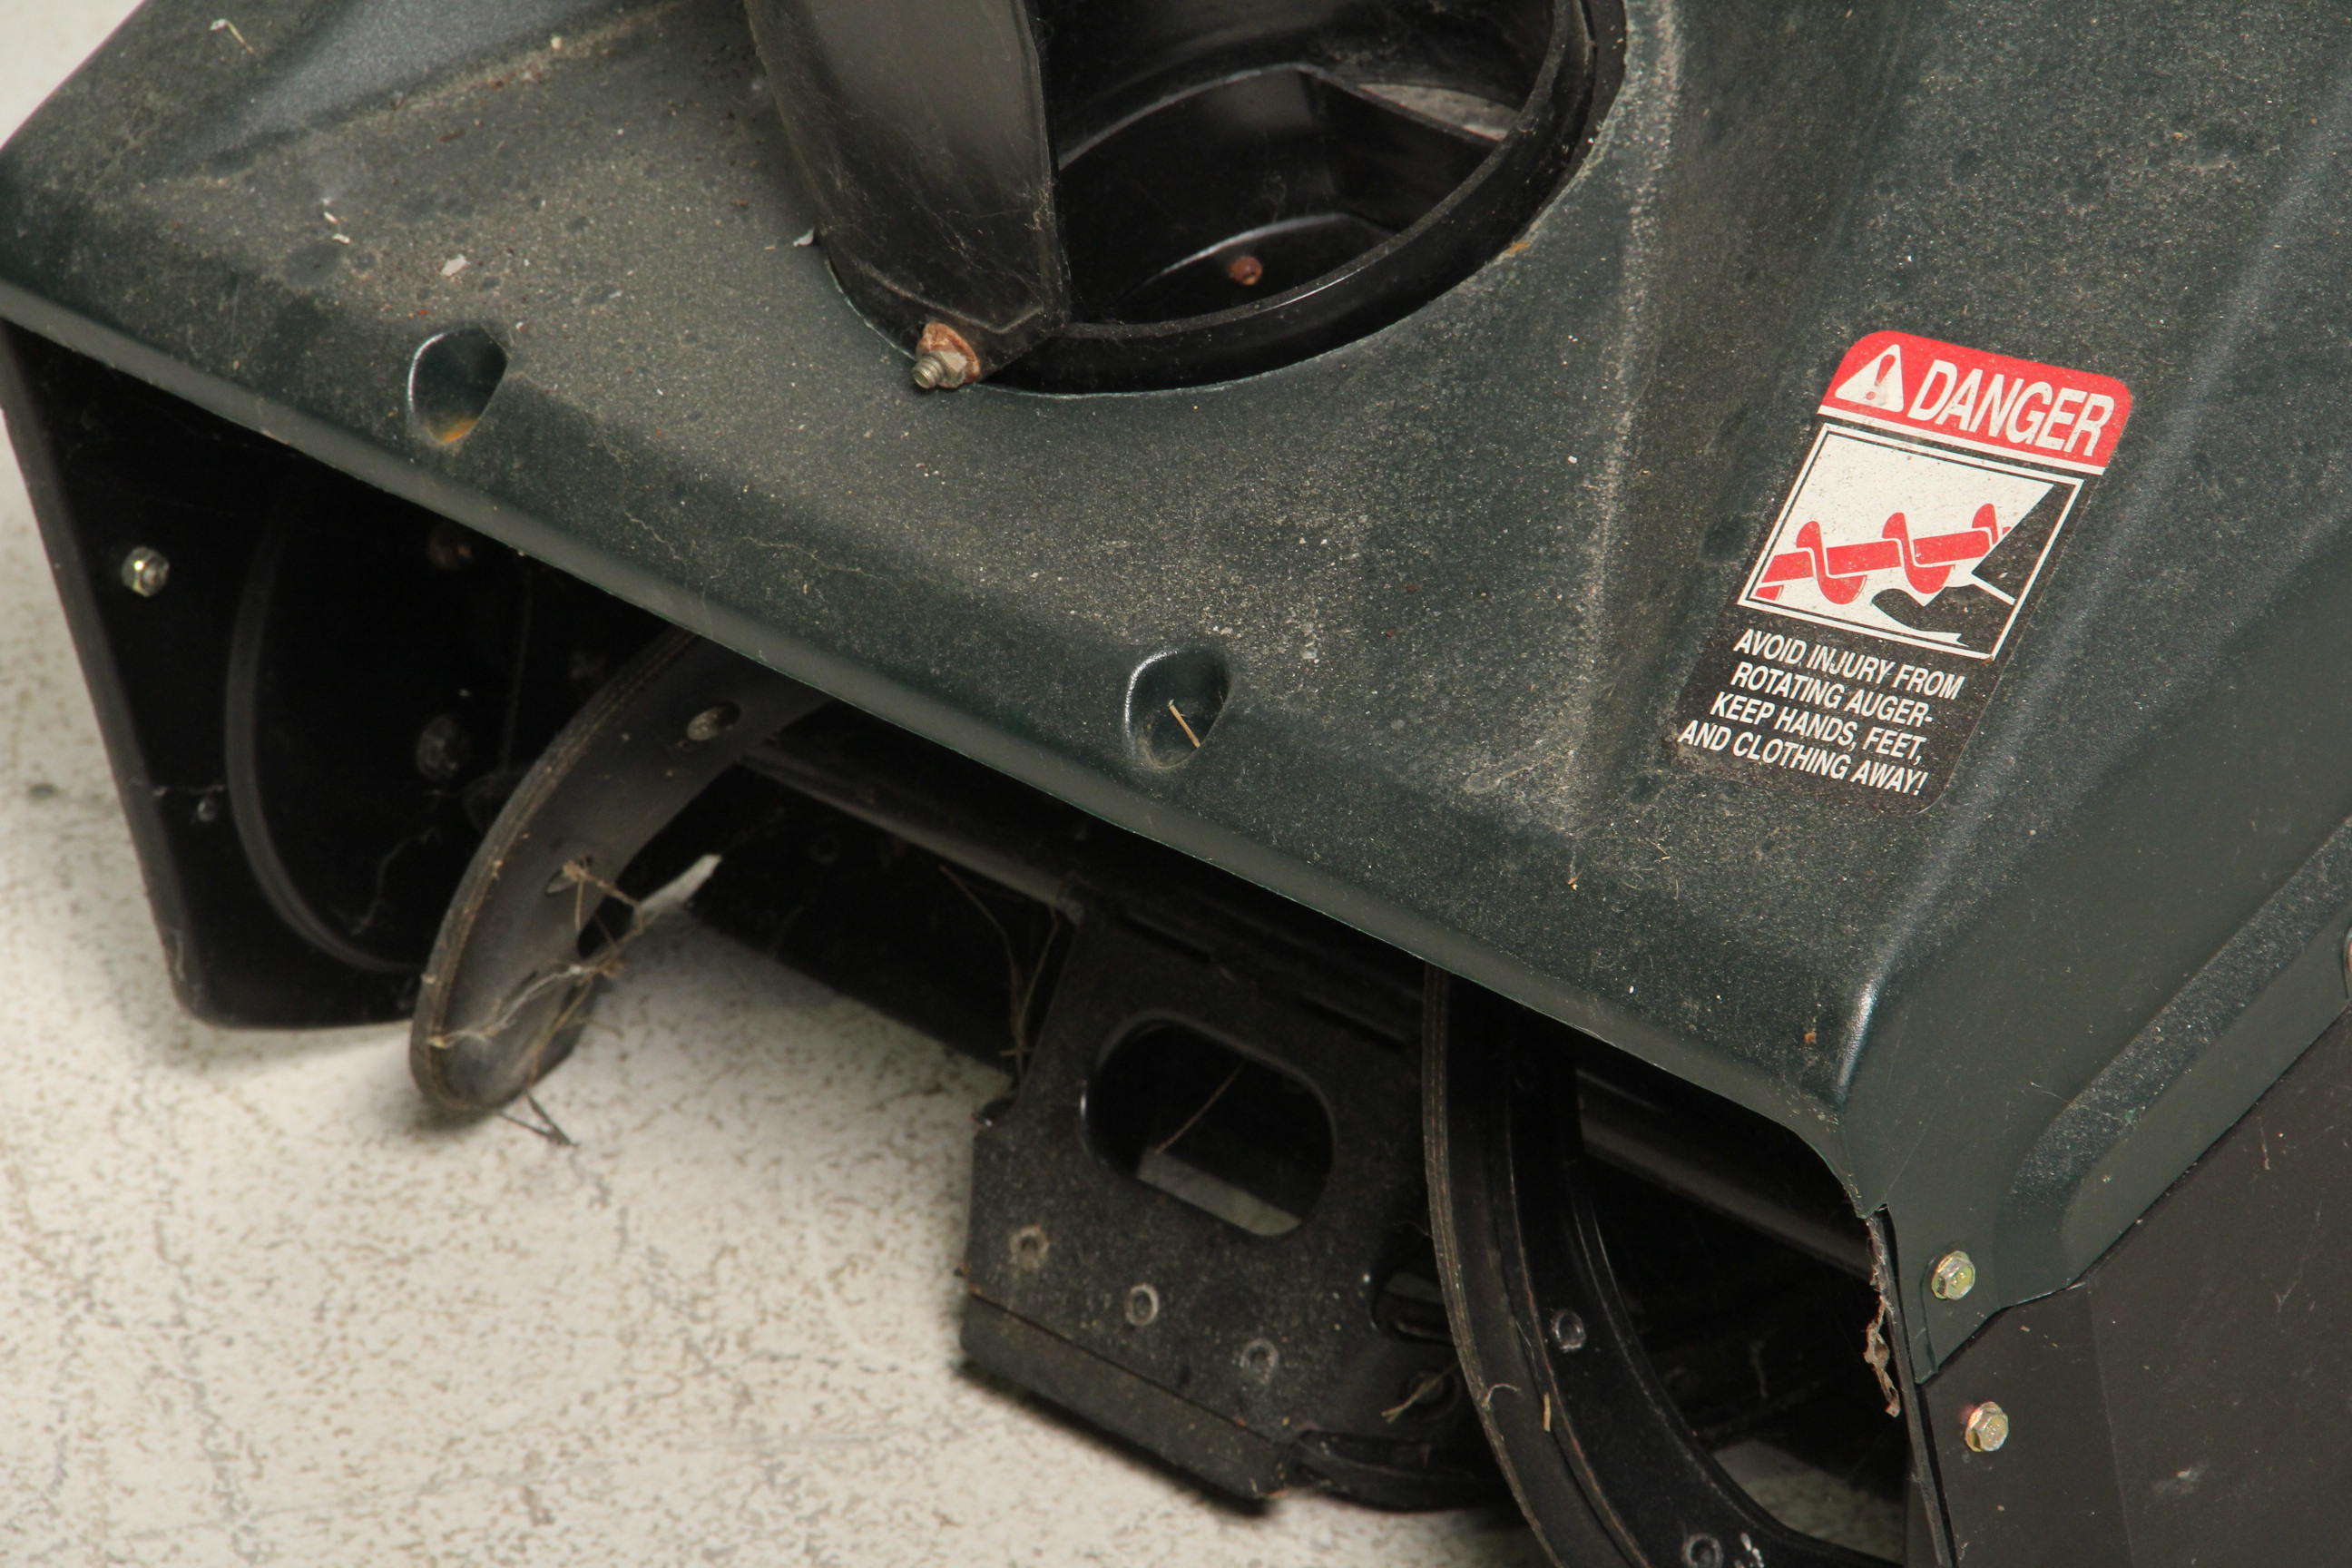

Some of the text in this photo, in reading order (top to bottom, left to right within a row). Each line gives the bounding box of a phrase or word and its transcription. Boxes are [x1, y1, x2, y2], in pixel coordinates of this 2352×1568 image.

[1907, 359, 2115, 456] DANGER
[1730, 662, 1845, 709] ROTATING
[1733, 629, 1965, 700] AVOID INJURY FROM
[1678, 720, 1929, 796] AND CLOTHING AWAY!
[1710, 691, 1927, 765] KEEP HANDS, FEET,
